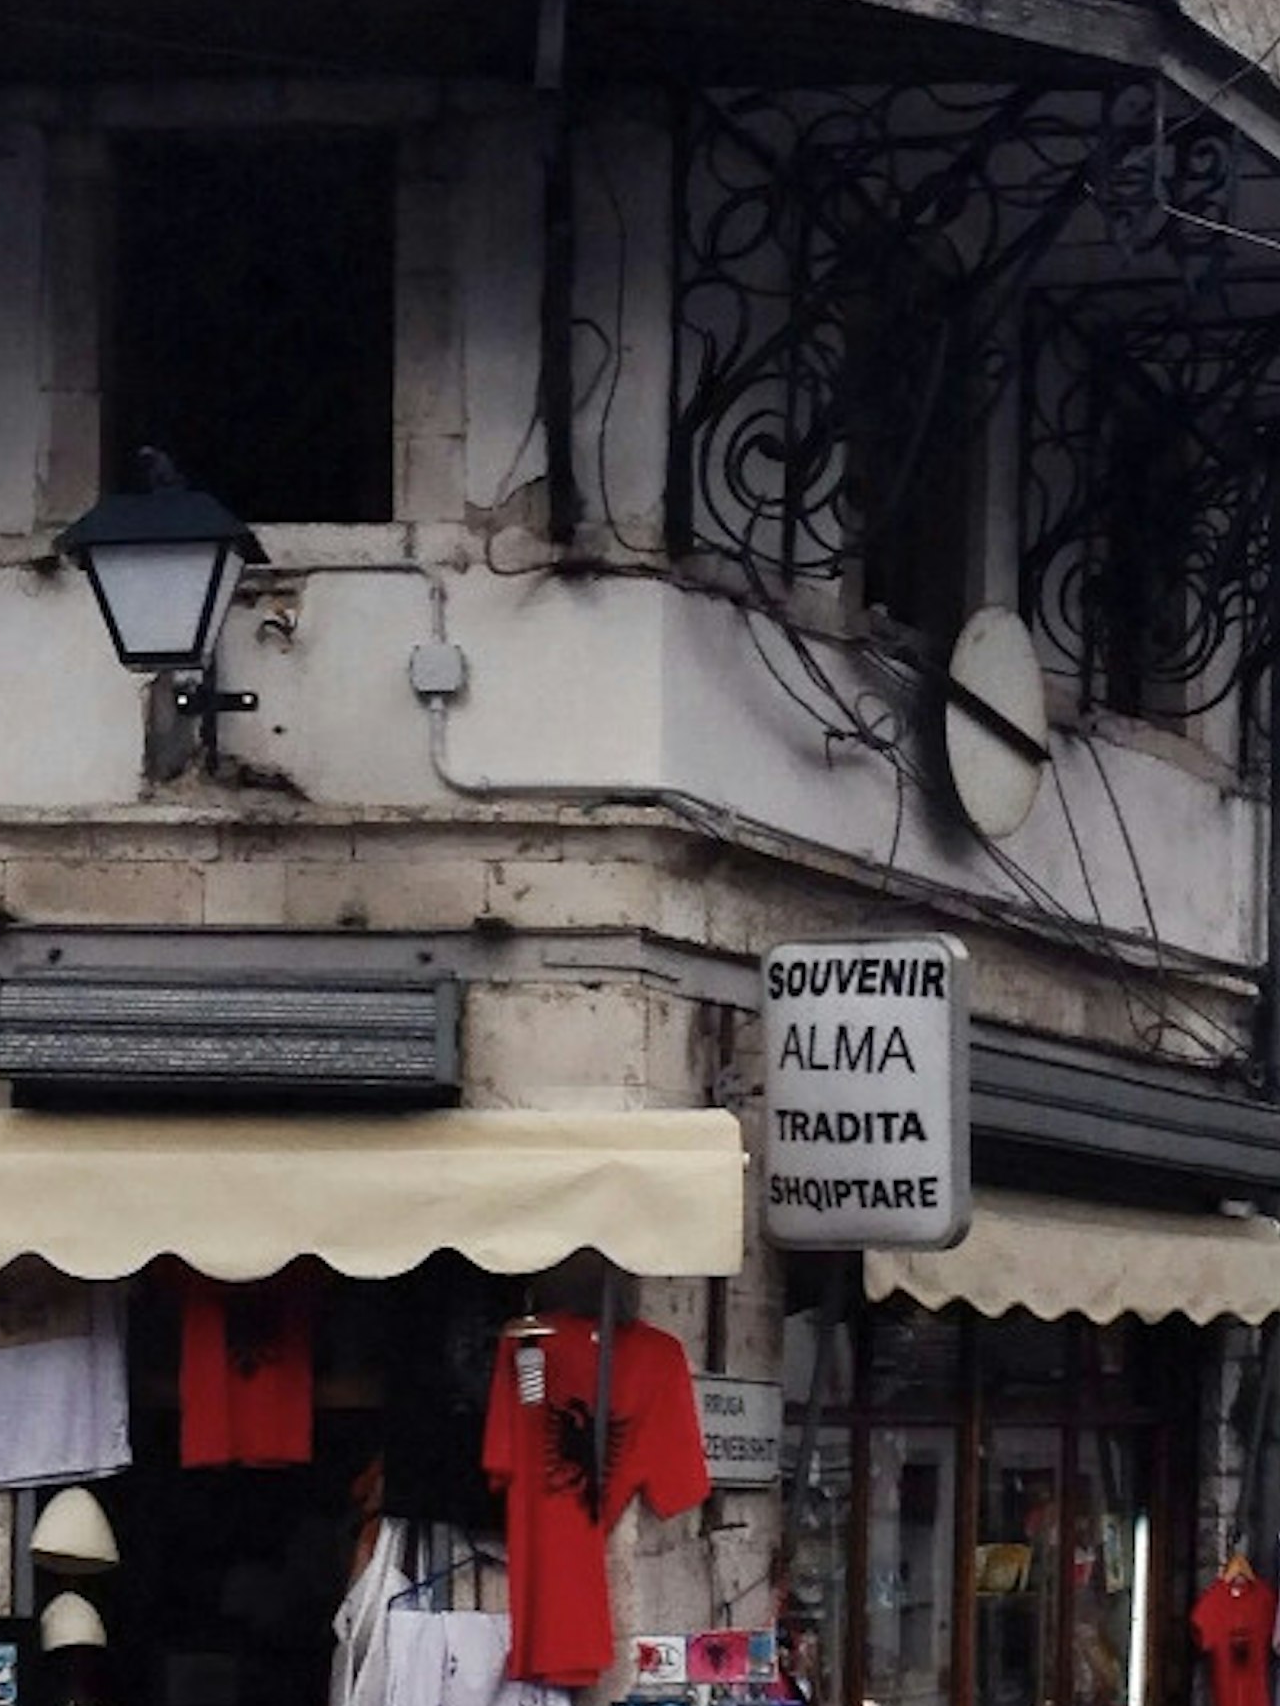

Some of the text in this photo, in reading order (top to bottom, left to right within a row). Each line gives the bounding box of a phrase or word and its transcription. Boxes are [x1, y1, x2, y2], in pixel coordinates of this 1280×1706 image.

[768, 958, 945, 1000] SOUVENIR
[779, 1022, 916, 1074] ALMA
[775, 1109, 927, 1144] TRADITA
[769, 1174, 938, 1212] SHQIPTARE
[704, 1394, 746, 1416] RRUGA
